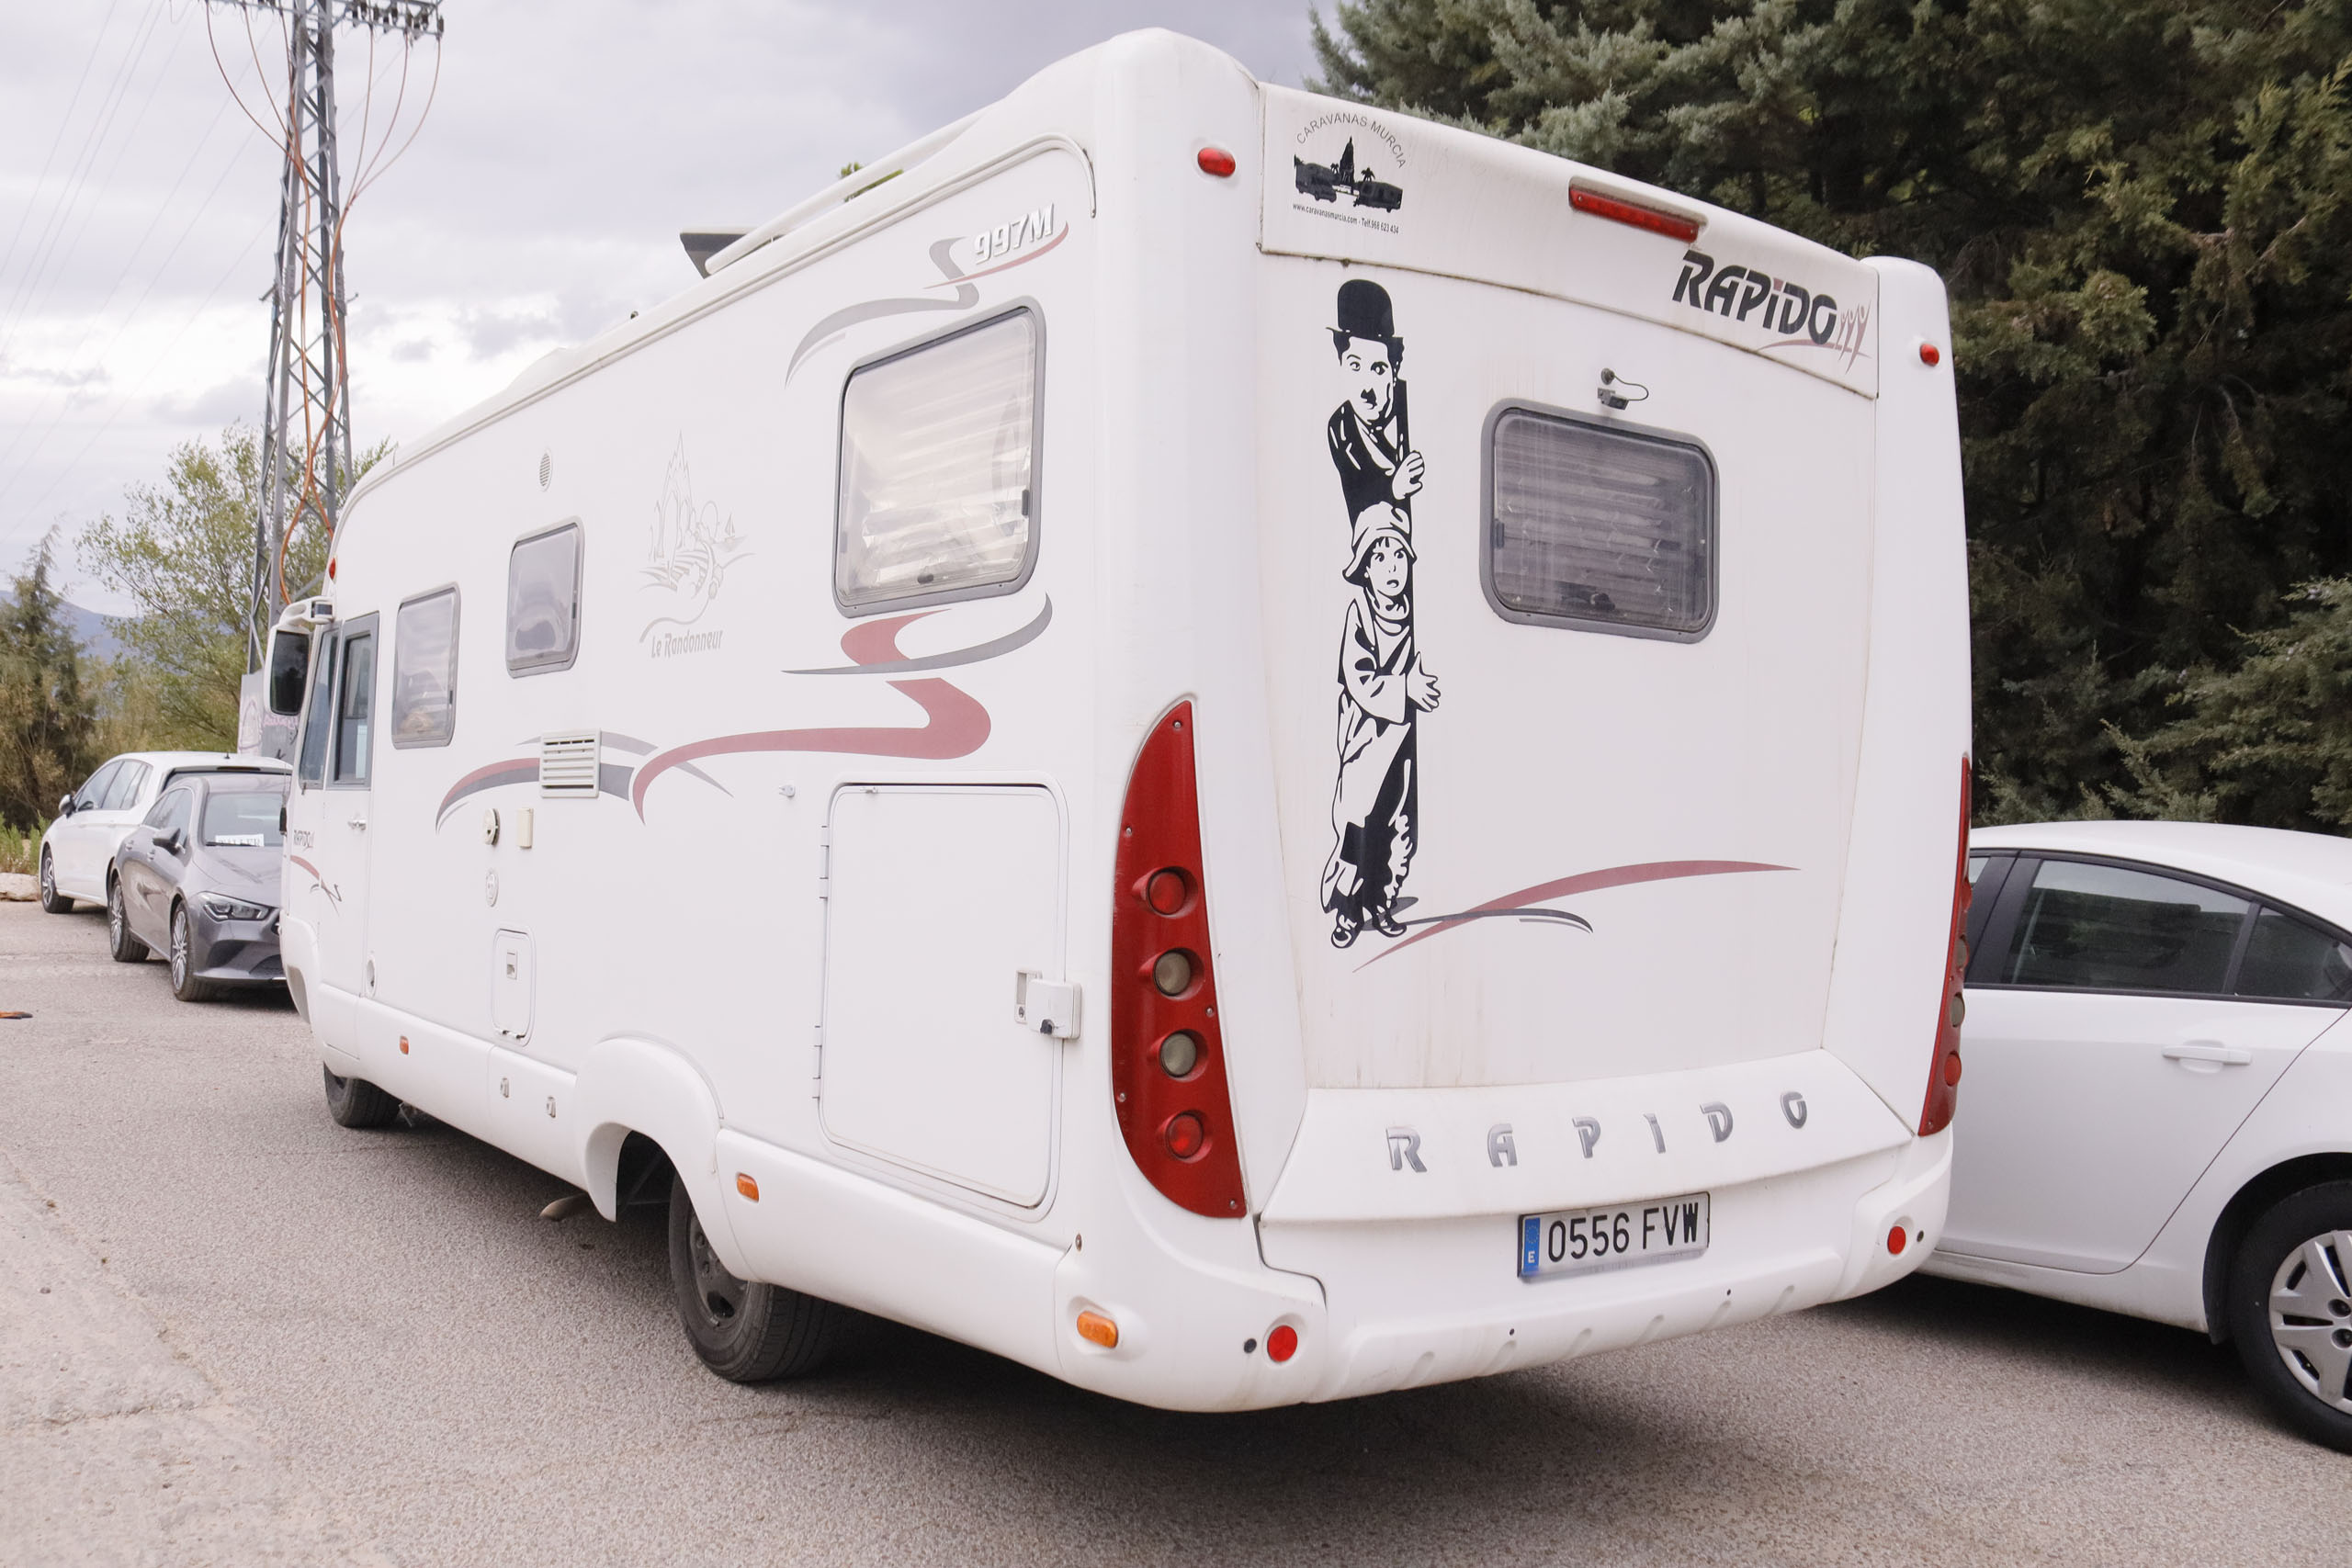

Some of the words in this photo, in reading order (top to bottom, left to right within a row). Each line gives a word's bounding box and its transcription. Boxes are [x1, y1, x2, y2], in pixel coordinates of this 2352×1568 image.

[1296, 112, 1368, 144] CARAVANAS
[1370, 120, 1407, 168] MURCIA
[974, 202, 1055, 265] 997M
[1292, 202, 1358, 225] www.caravanasmurcia.com
[650, 635, 662, 659] Le
[664, 628, 723, 659] Randonneur
[1548, 1212, 1630, 1263] 0556
[1642, 1201, 1699, 1250] FVW
[1527, 1250, 1535, 1263] E
